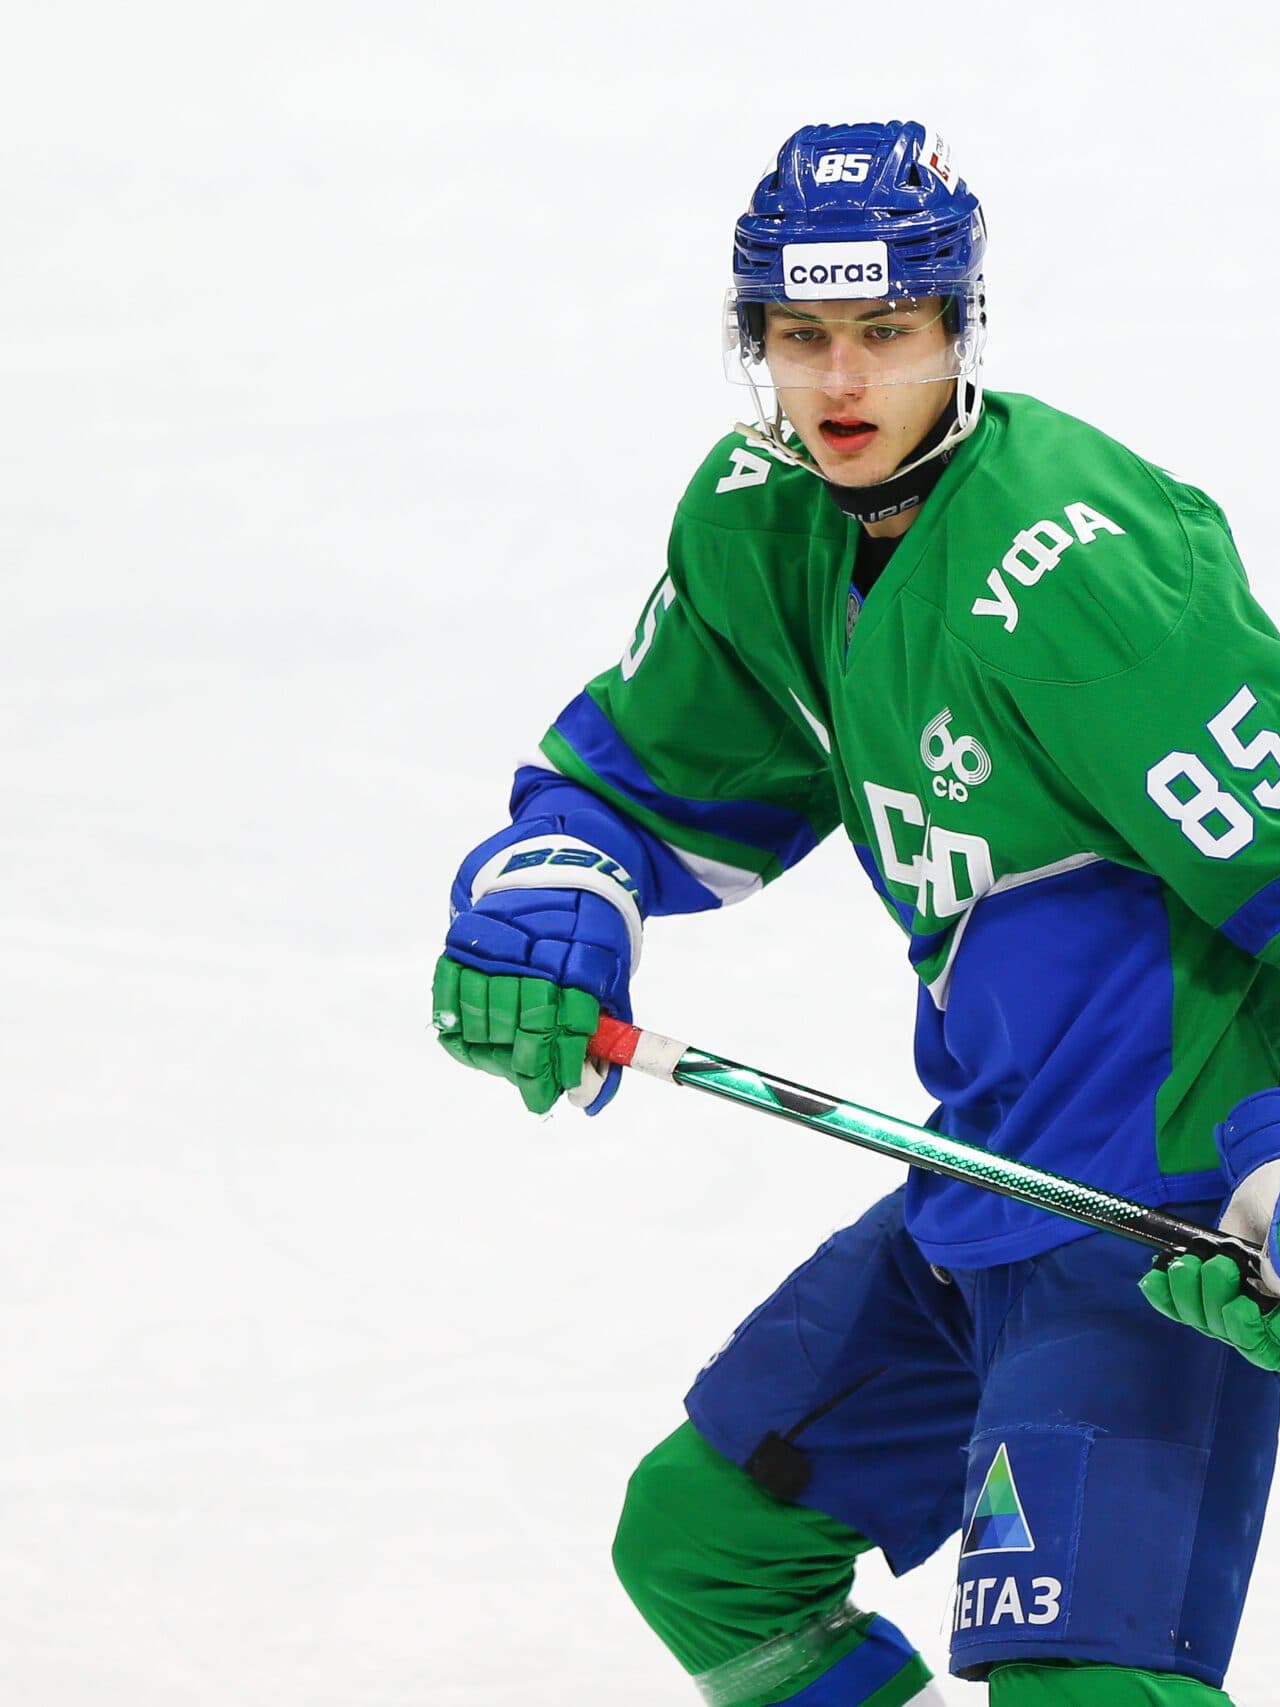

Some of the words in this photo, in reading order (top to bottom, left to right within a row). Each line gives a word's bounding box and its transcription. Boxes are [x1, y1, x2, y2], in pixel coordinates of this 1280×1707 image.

[815, 153, 872, 184] 85
[971, 501, 1126, 634] УФА
[920, 706, 992, 786] 60
[954, 1576, 1063, 1632] ЕГАЗ
